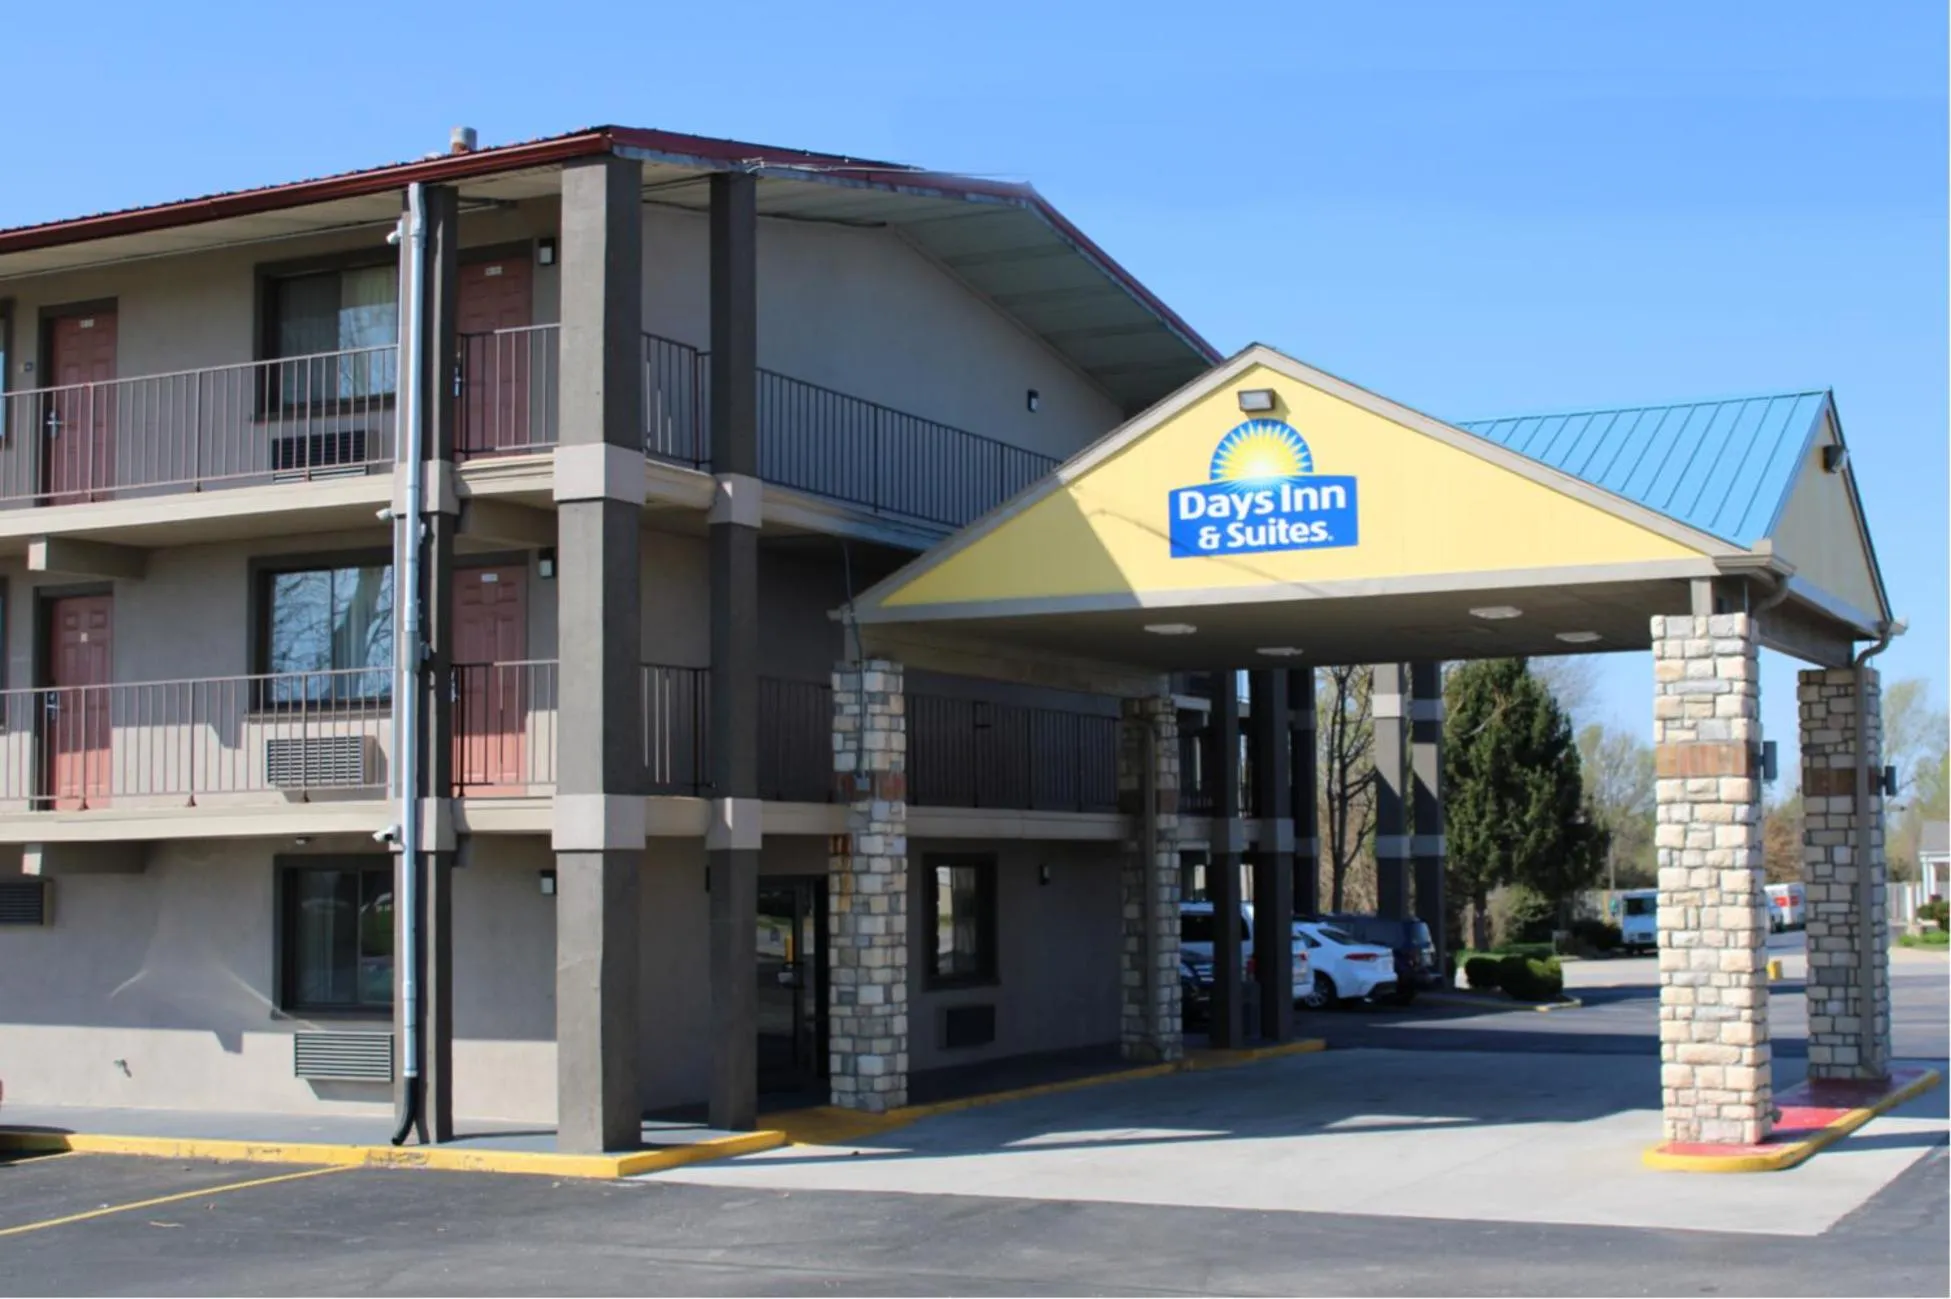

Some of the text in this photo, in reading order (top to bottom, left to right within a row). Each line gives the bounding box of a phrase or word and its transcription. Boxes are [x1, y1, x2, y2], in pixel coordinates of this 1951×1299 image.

[1178, 483, 1346, 521] Days Inn
[1198, 526, 1221, 550] &
